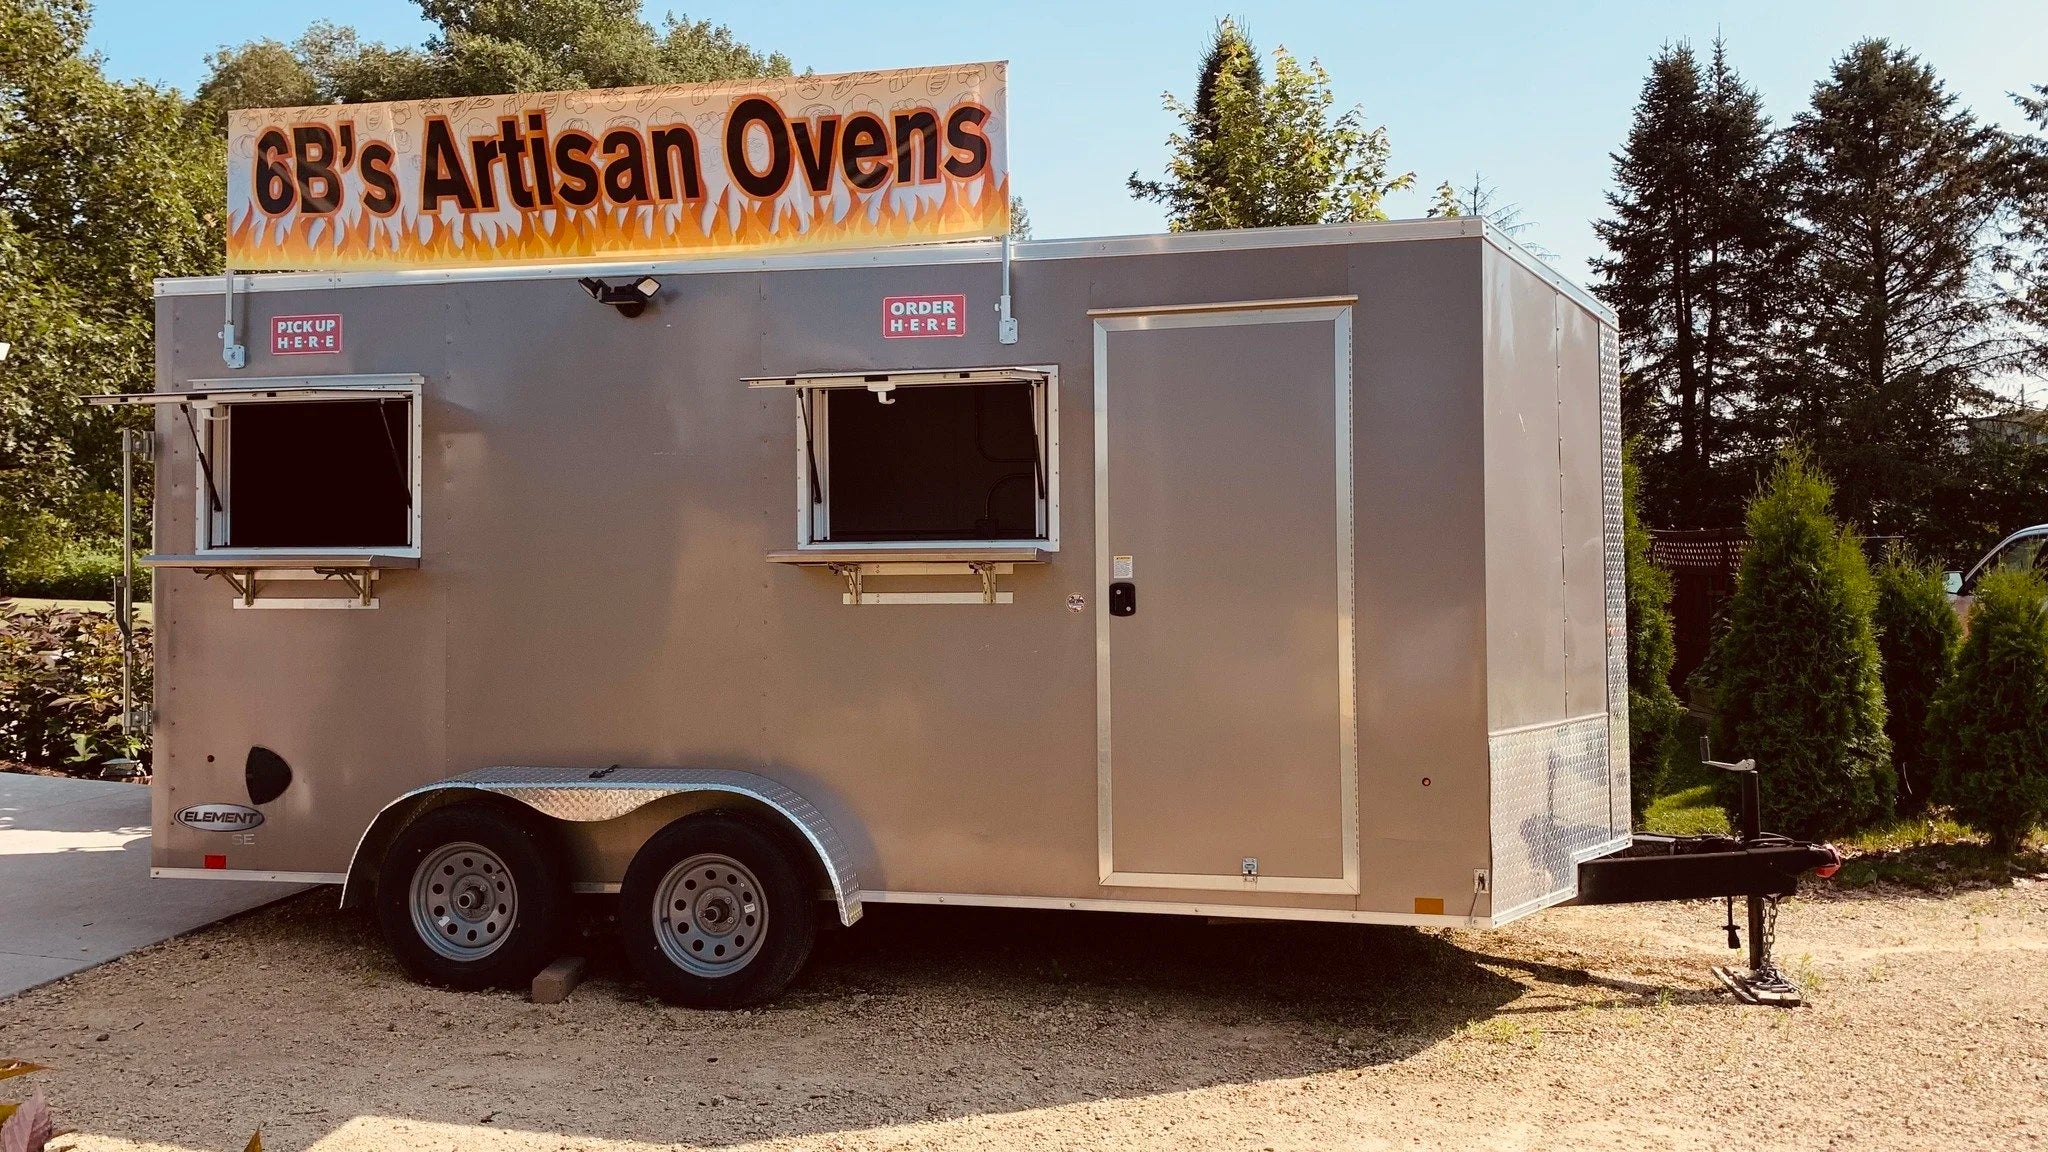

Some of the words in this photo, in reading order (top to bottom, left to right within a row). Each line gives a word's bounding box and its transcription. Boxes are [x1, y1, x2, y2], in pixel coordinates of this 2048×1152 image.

[253, 122, 398, 215] 6B's
[420, 109, 701, 213] Artisan
[725, 96, 991, 200] Ovens
[890, 301, 955, 315] ORDER
[184, 812, 257, 823] ELEMENT
